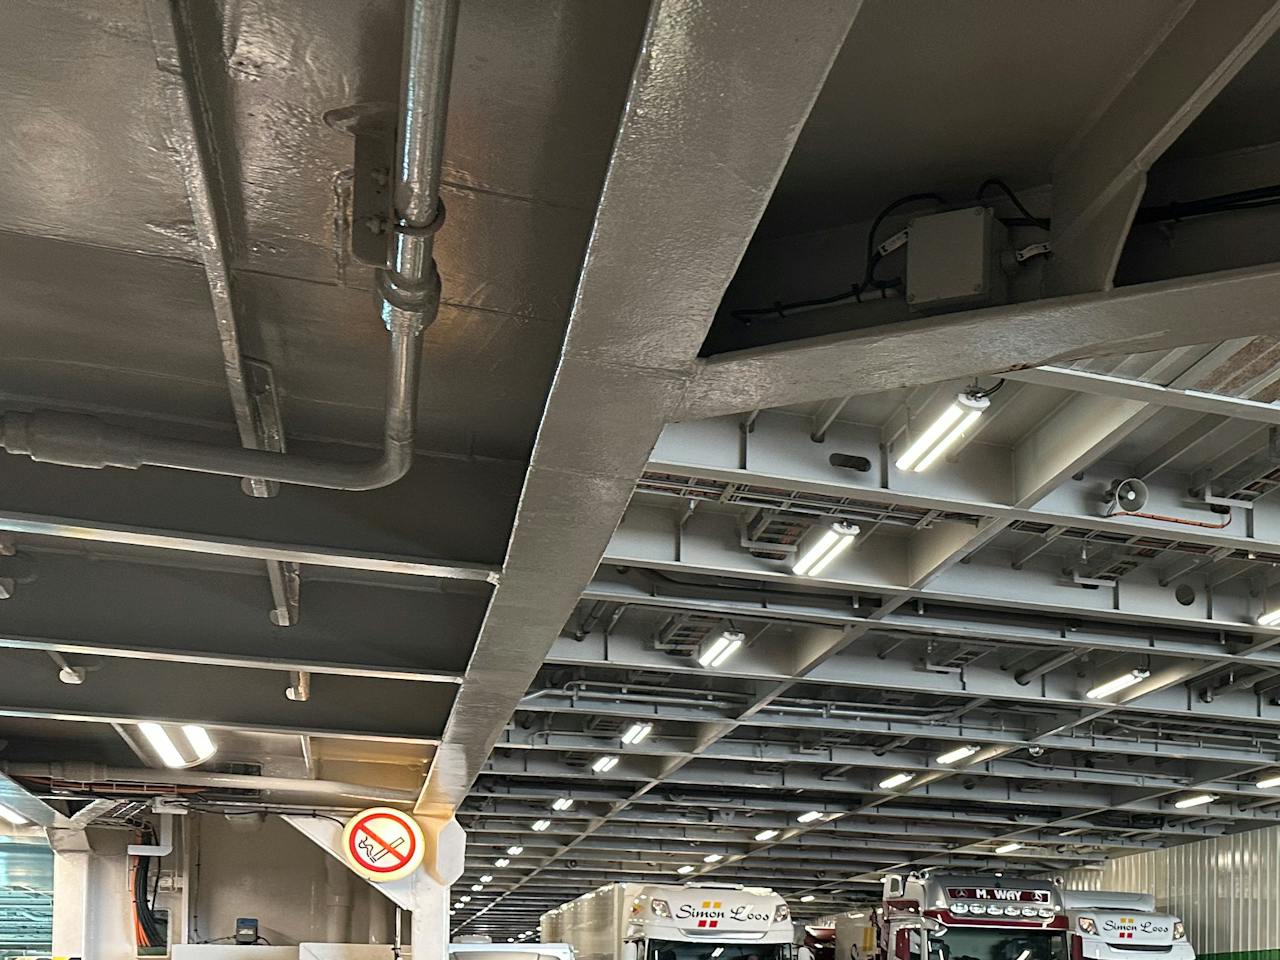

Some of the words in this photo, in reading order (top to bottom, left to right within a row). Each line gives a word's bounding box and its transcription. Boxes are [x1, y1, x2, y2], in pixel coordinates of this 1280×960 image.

[976, 889, 991, 899] M.
[994, 889, 1021, 901] WAY
[676, 904, 724, 919] Simon
[730, 905, 769, 922] Loos
[1103, 919, 1137, 931] Simon
[1140, 921, 1169, 934] Loos
